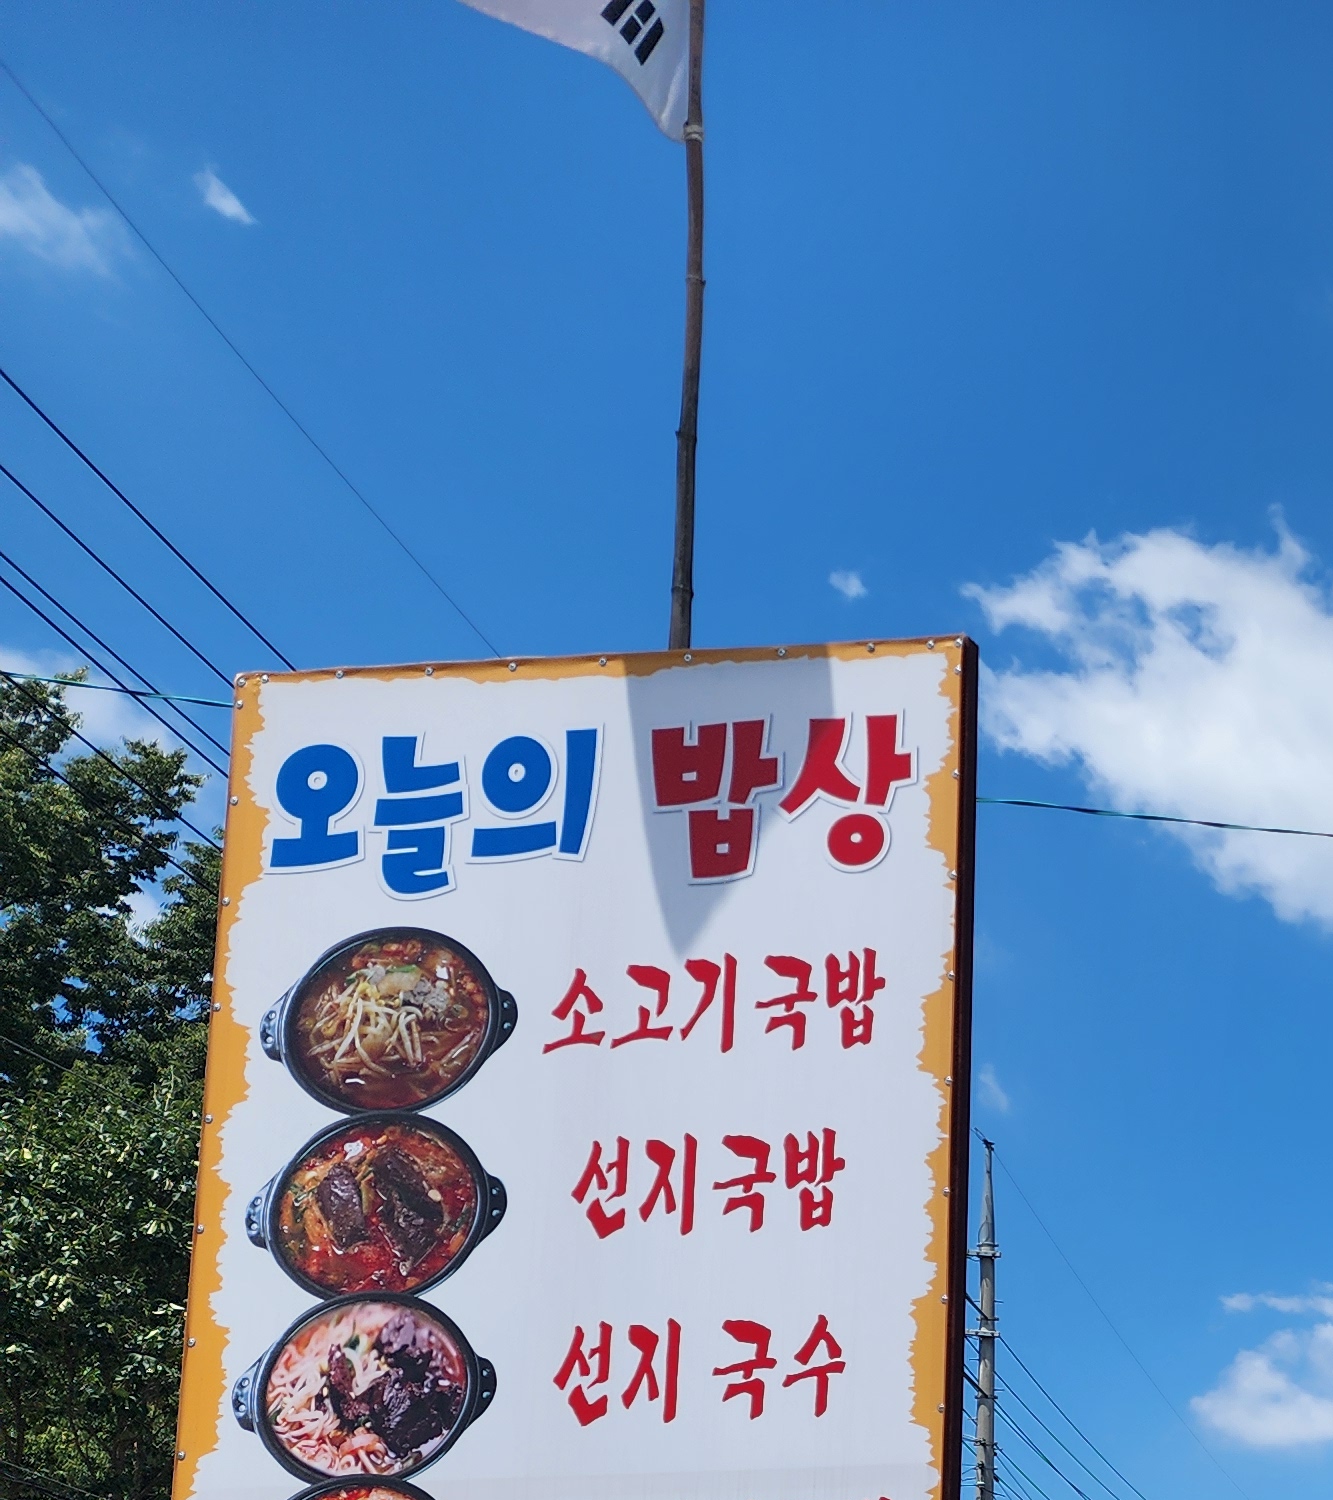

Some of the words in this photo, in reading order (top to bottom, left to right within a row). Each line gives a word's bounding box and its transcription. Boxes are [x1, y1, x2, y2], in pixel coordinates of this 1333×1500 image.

[270, 729, 597, 894] 오늘의
[651, 714, 913, 877] 밥상
[543, 947, 886, 1054] 소고기국밥
[572, 1127, 846, 1238] 선지국밥
